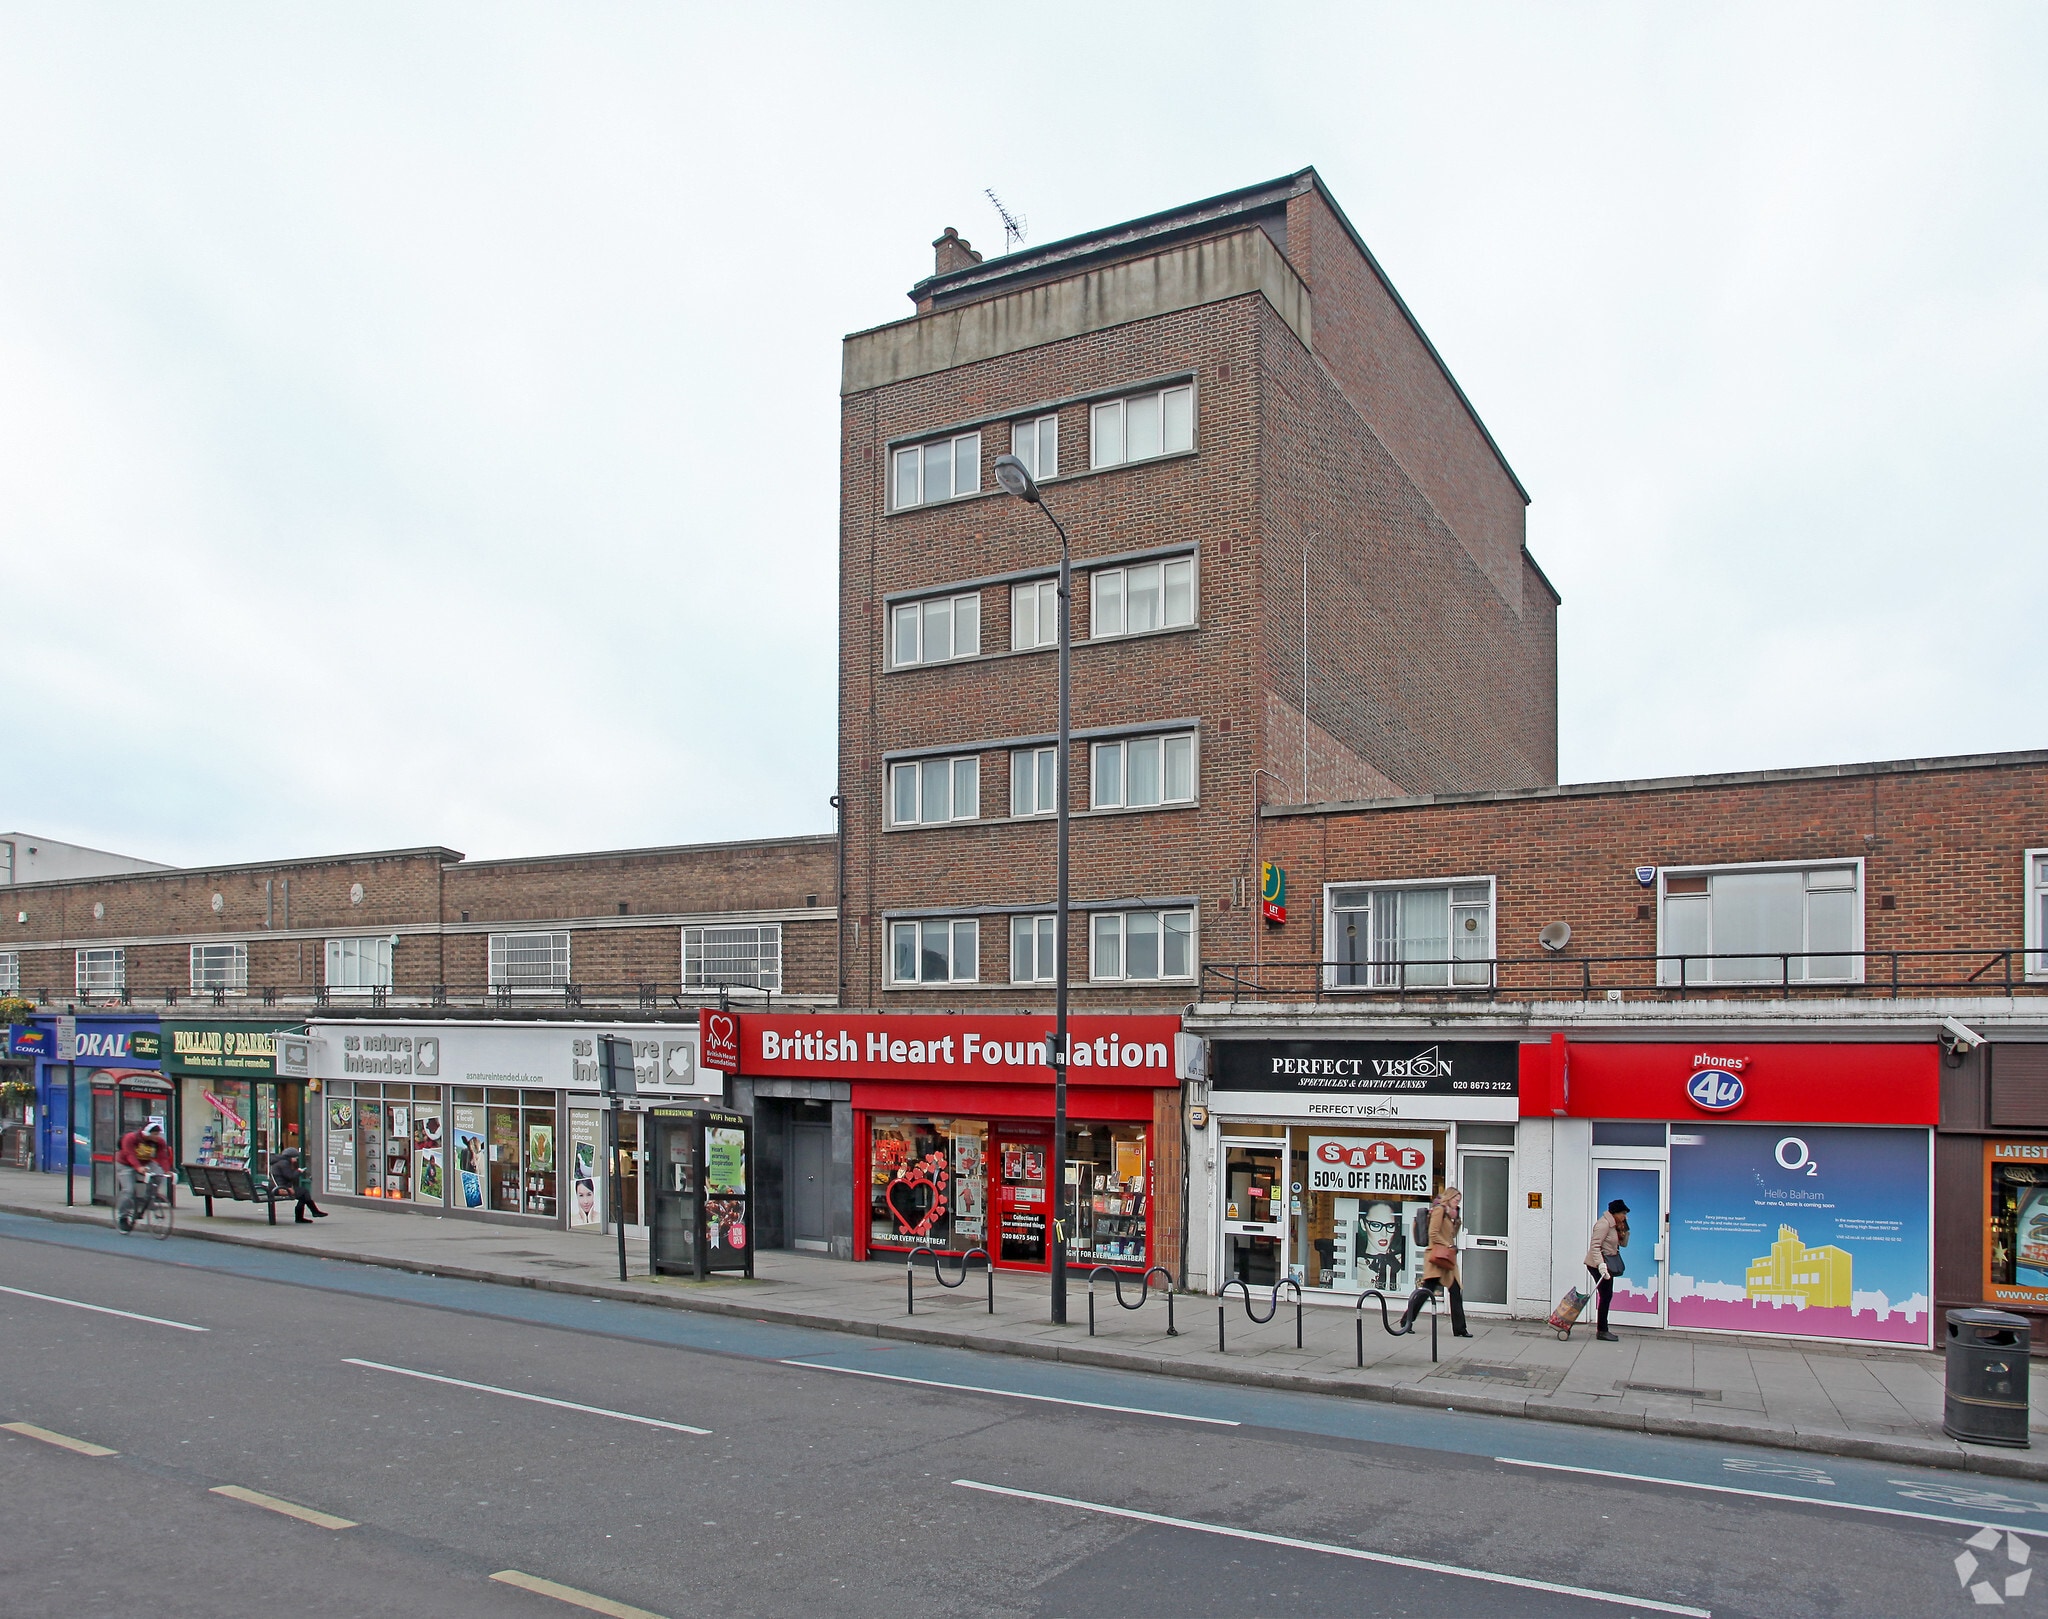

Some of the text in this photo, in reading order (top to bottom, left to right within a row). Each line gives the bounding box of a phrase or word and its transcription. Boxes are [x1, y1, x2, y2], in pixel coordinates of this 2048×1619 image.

[1270, 904, 1279, 914] LET
[76, 1033, 127, 1057] ORAL
[174, 1032, 222, 1052] HOLLAND
[224, 1032, 235, 1055] &
[344, 1034, 412, 1052] as nature
[572, 1039, 592, 1057] as
[762, 1030, 1168, 1067] British Heart Founation
[15, 1045, 45, 1054] CORAL
[706, 1050, 722, 1058] British
[184, 1056, 271, 1068] health foods & natural remedies
[344, 1053, 412, 1074] intended
[706, 1057, 736, 1067] Foundation
[1694, 1053, 1743, 1069] phones
[572, 1058, 659, 1084] inted
[1271, 1058, 1362, 1076] PERFECT
[466, 1072, 544, 1083] asnatureintended.uk.com
[1298, 1077, 1428, 1089] SPECTACLES & CONTACT LENSES
[1453, 1081, 1512, 1091] 020 8673 2122
[1693, 1072, 1739, 1105] 4u
[1309, 1104, 1354, 1115] PERFECT
[571, 1119, 594, 1127] remedies
[710, 1112, 737, 1123] WiFi here
[571, 1133, 593, 1141] skincare
[1324, 1145, 1417, 1167] SALE
[1314, 1171, 1427, 1192] 50% OFF FRAMES
[1764, 1189, 1824, 1200] Hello Balham
[1013, 1214, 1034, 1222] Collection
[1032, 1222, 1046, 1230] things
[916, 1236, 946, 1246] HEARTBEAT
[1066, 1249, 1079, 1258] IGHT
[1080, 1250, 1092, 1258] FOR
[1092, 1251, 1110, 1260] EVERY
